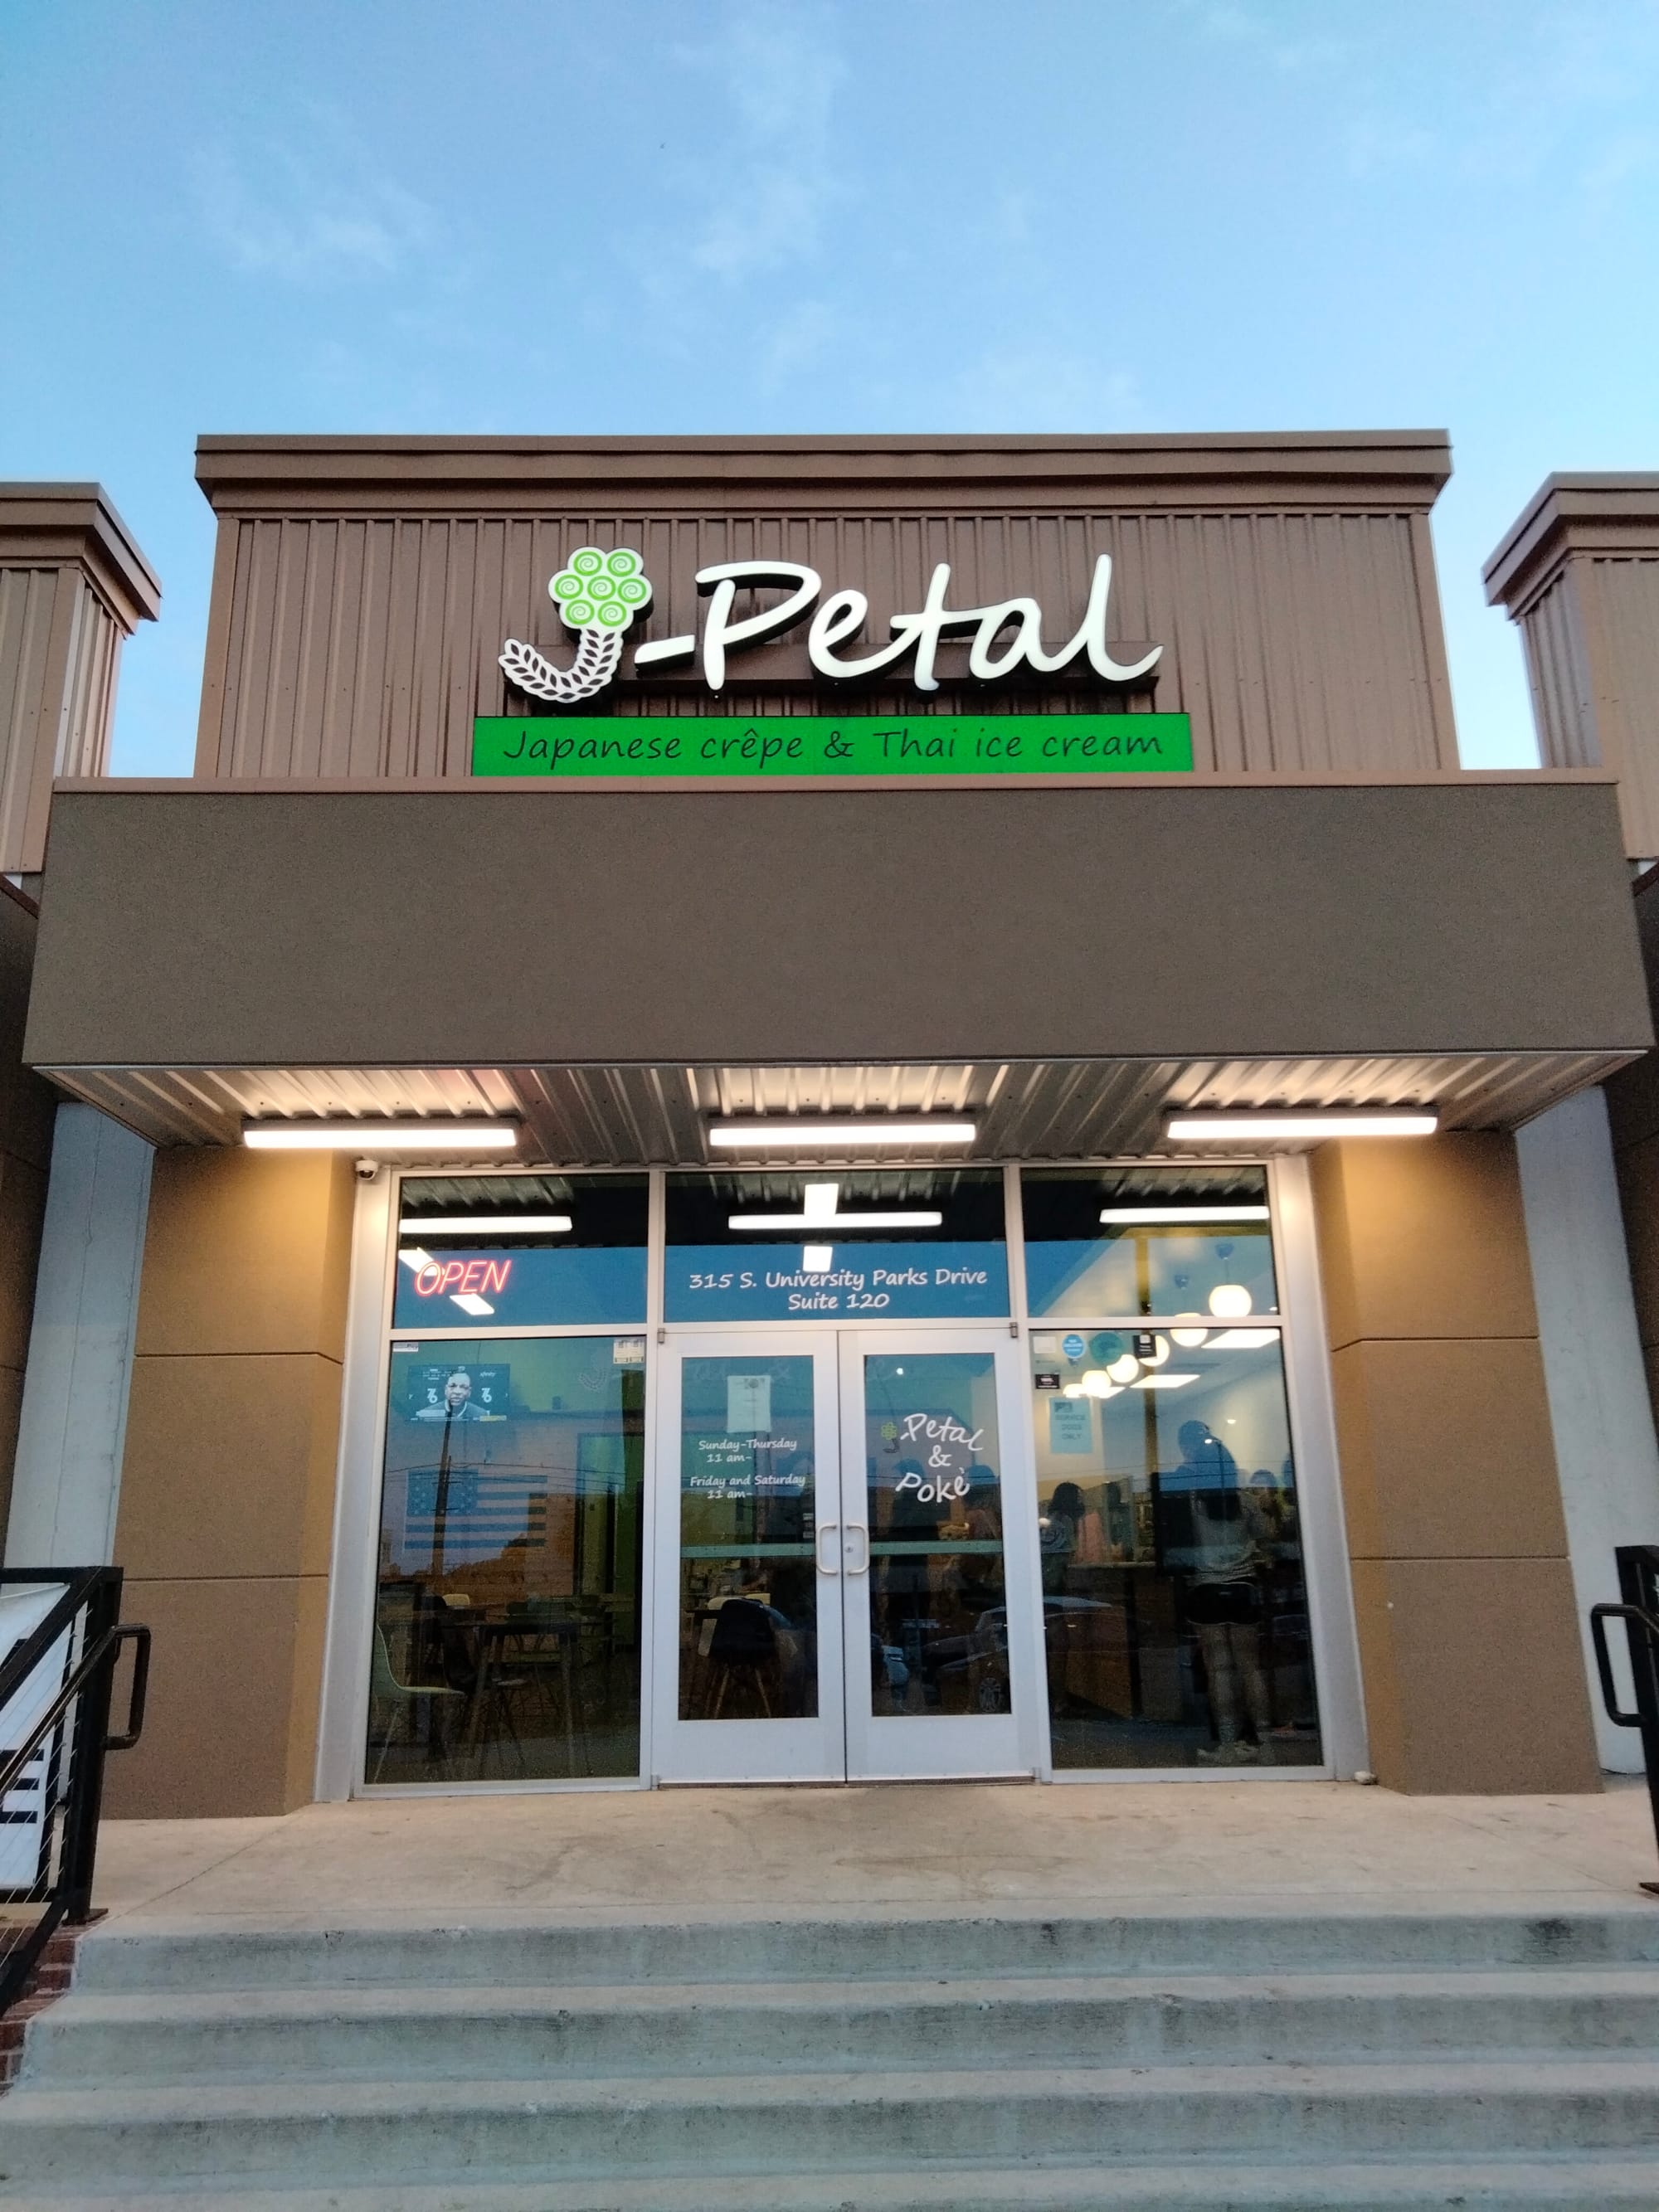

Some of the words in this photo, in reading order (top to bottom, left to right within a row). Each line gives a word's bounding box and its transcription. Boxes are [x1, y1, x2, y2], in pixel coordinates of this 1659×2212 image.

[504, 730, 682, 771] Japanese
[700, 728, 803, 768] crêpe
[824, 731, 854, 758] &
[873, 728, 958, 758] Thai
[975, 728, 1023, 758] ice
[1042, 735, 1163, 756] cream
[414, 1259, 512, 1297] OPEN
[689, 1273, 733, 1289] 315
[740, 1272, 757, 1289] S.
[766, 1269, 865, 1291] University
[873, 1270, 927, 1286] Parks
[936, 1266, 988, 1285] Drive
[788, 1291, 839, 1310] Suite
[846, 1293, 890, 1308] 120
[698, 1437, 797, 1452] Sunday-Thursday
[707, 1454, 722, 1463] 11
[726, 1455, 752, 1463] am-
[927, 1444, 952, 1467] &
[689, 1475, 730, 1489] Friday
[729, 1475, 751, 1485] and
[754, 1473, 806, 1487] Saturday
[707, 1490, 723, 1500] 11
[727, 1490, 753, 1499] am-
